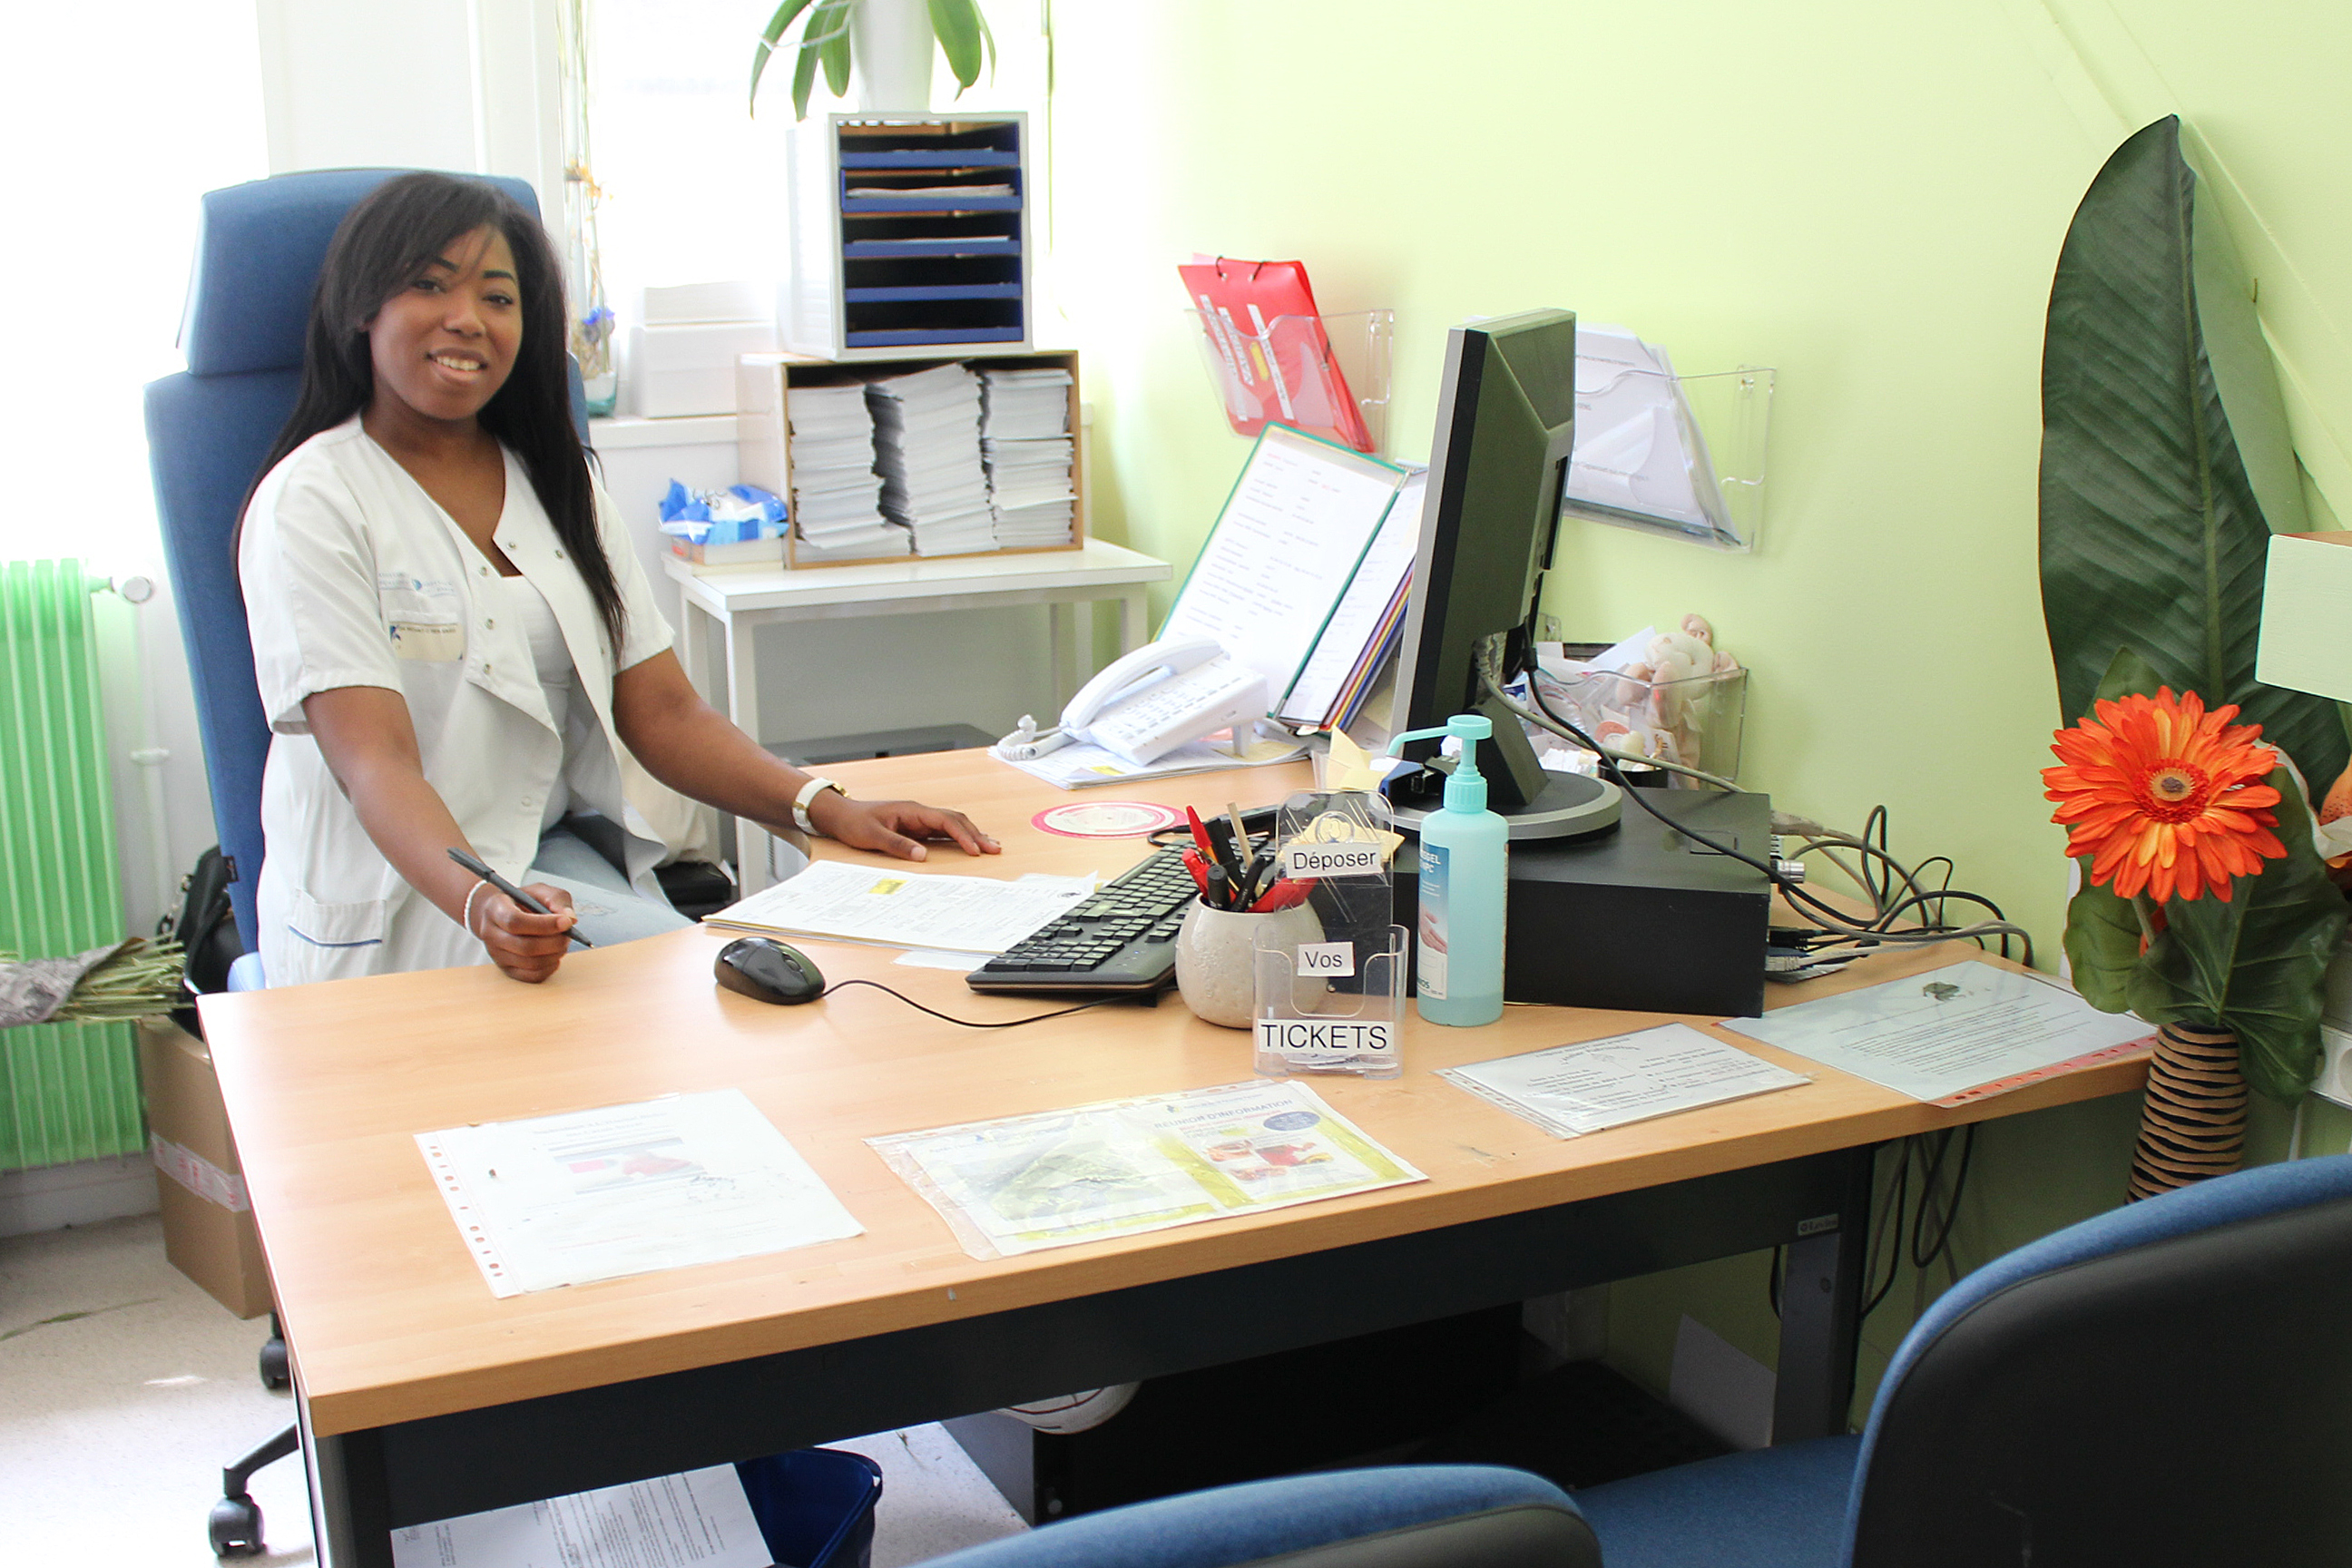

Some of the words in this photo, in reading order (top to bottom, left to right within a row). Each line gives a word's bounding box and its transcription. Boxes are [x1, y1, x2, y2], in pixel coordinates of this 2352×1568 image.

[1294, 850, 1377, 872] Déposer
[1305, 949, 1343, 969] Vos
[1260, 1024, 1387, 1049] TICKETS
[1207, 1099, 1293, 1122] D'INFORMATION
